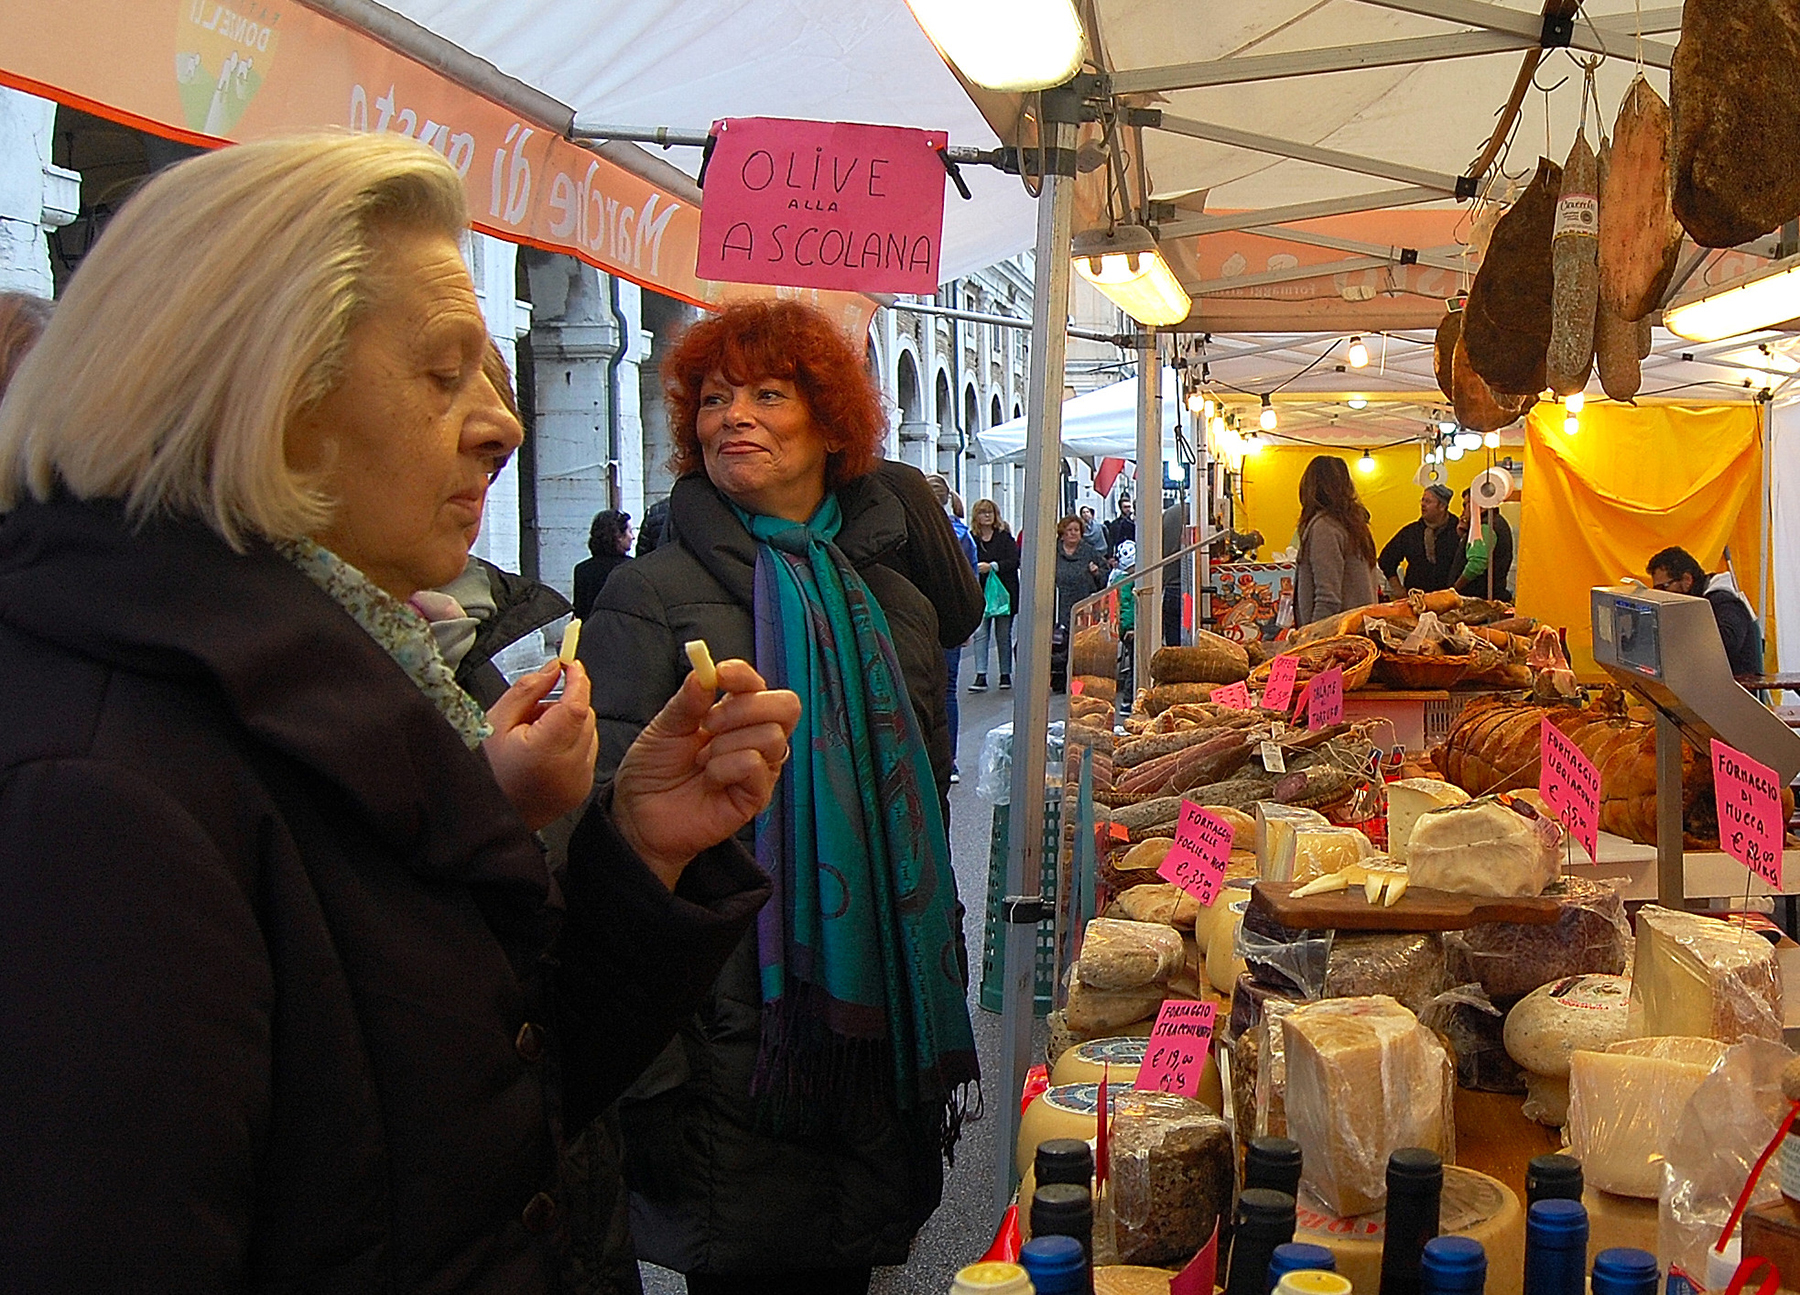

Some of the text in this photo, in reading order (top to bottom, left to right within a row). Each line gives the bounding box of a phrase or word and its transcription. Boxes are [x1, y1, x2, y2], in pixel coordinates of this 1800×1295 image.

[788, 199, 838, 211] ALLA
[721, 222, 931, 274] ASCOLANA
[1548, 731, 1598, 792] FORMAGGIO
[1718, 754, 1778, 801] FORMAGGIO
[1549, 784, 1558, 802] €
[1741, 789, 1753, 806] DI
[1177, 835, 1203, 857] FOGLIE
[1199, 832, 1218, 847] ALLE
[1731, 831, 1744, 853] €
[1176, 862, 1189, 876] €
[1162, 1004, 1211, 1019] FORMAGGIO
[1152, 1048, 1165, 1068] €
